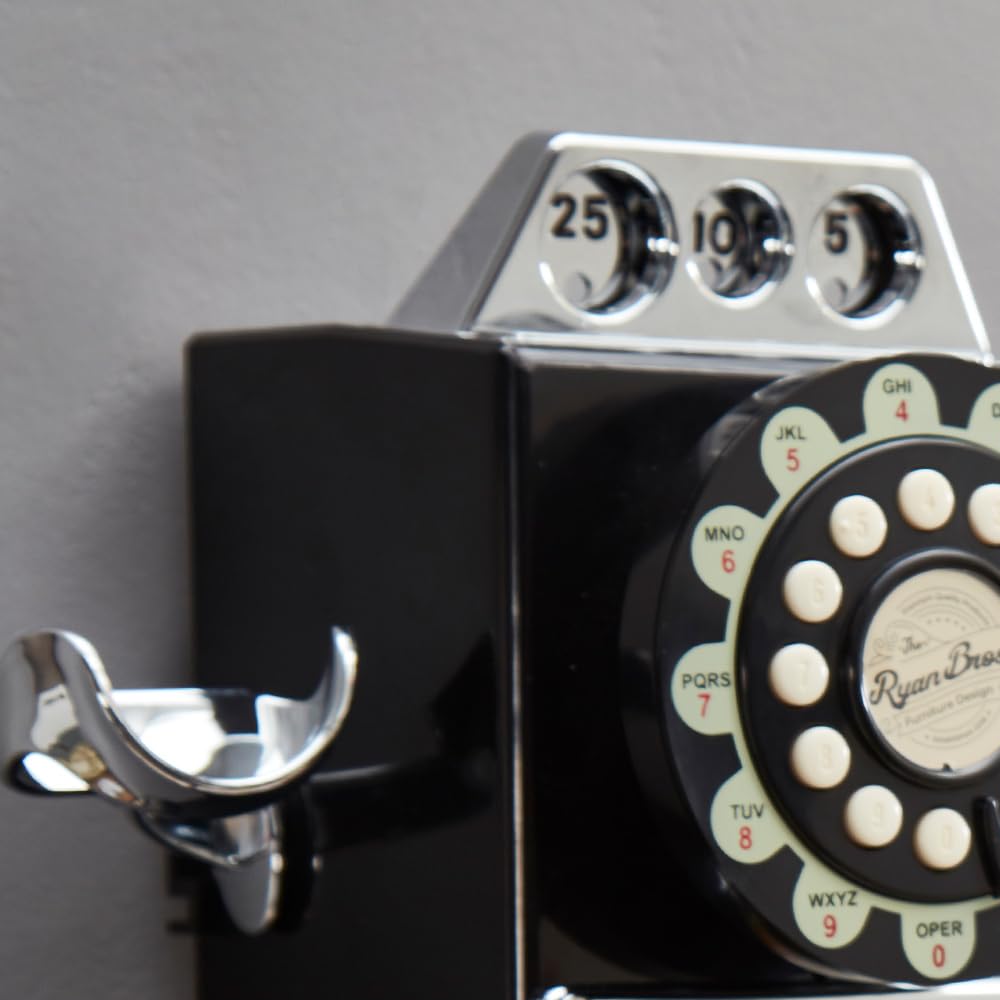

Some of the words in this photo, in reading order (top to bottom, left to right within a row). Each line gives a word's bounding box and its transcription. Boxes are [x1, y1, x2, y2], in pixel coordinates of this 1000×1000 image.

[550, 193, 609, 240] 25
[692, 211, 736, 254] 10
[823, 210, 849, 253] 5
[882, 379, 912, 395] GHI
[895, 401, 909, 422] 4
[775, 425, 806, 441] JKL
[786, 449, 800, 472] 5
[705, 526, 745, 542] MNO
[721, 550, 736, 573] 6
[682, 672, 731, 690] PQRS
[869, 669, 941, 709] Ryan
[698, 695, 711, 717] 7
[904, 700, 954, 727] Furniture
[955, 685, 995, 706] Design
[730, 804, 764, 820] TUV
[738, 827, 752, 849] 8
[808, 890, 858, 908] WXYZ
[823, 915, 837, 938] 9
[916, 921, 964, 938] OPER
[931, 945, 946, 968] 0
